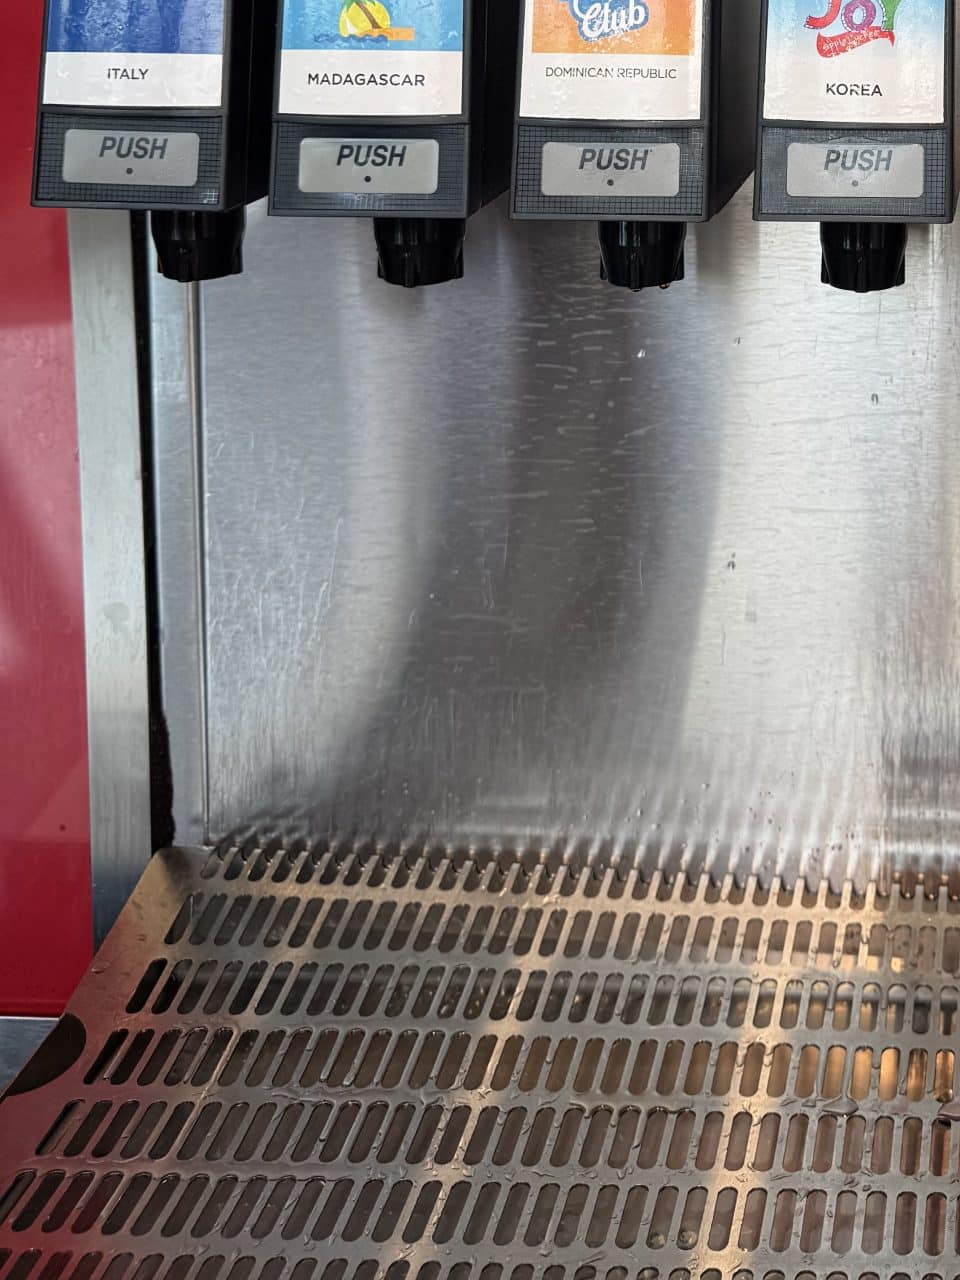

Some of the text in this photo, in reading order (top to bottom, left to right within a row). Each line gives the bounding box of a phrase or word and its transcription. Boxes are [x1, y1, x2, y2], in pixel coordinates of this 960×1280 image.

[106, 67, 149, 81] ITALY
[307, 73, 426, 87] MADAGASCAR
[545, 66, 677, 80] DOMINICAN REPUBLIC
[826, 83, 883, 97] KOREA
[99, 136, 168, 161] PUSH
[336, 144, 408, 168] PUSH
[578, 147, 649, 171] PUSH
[823, 148, 893, 172] PUSH
